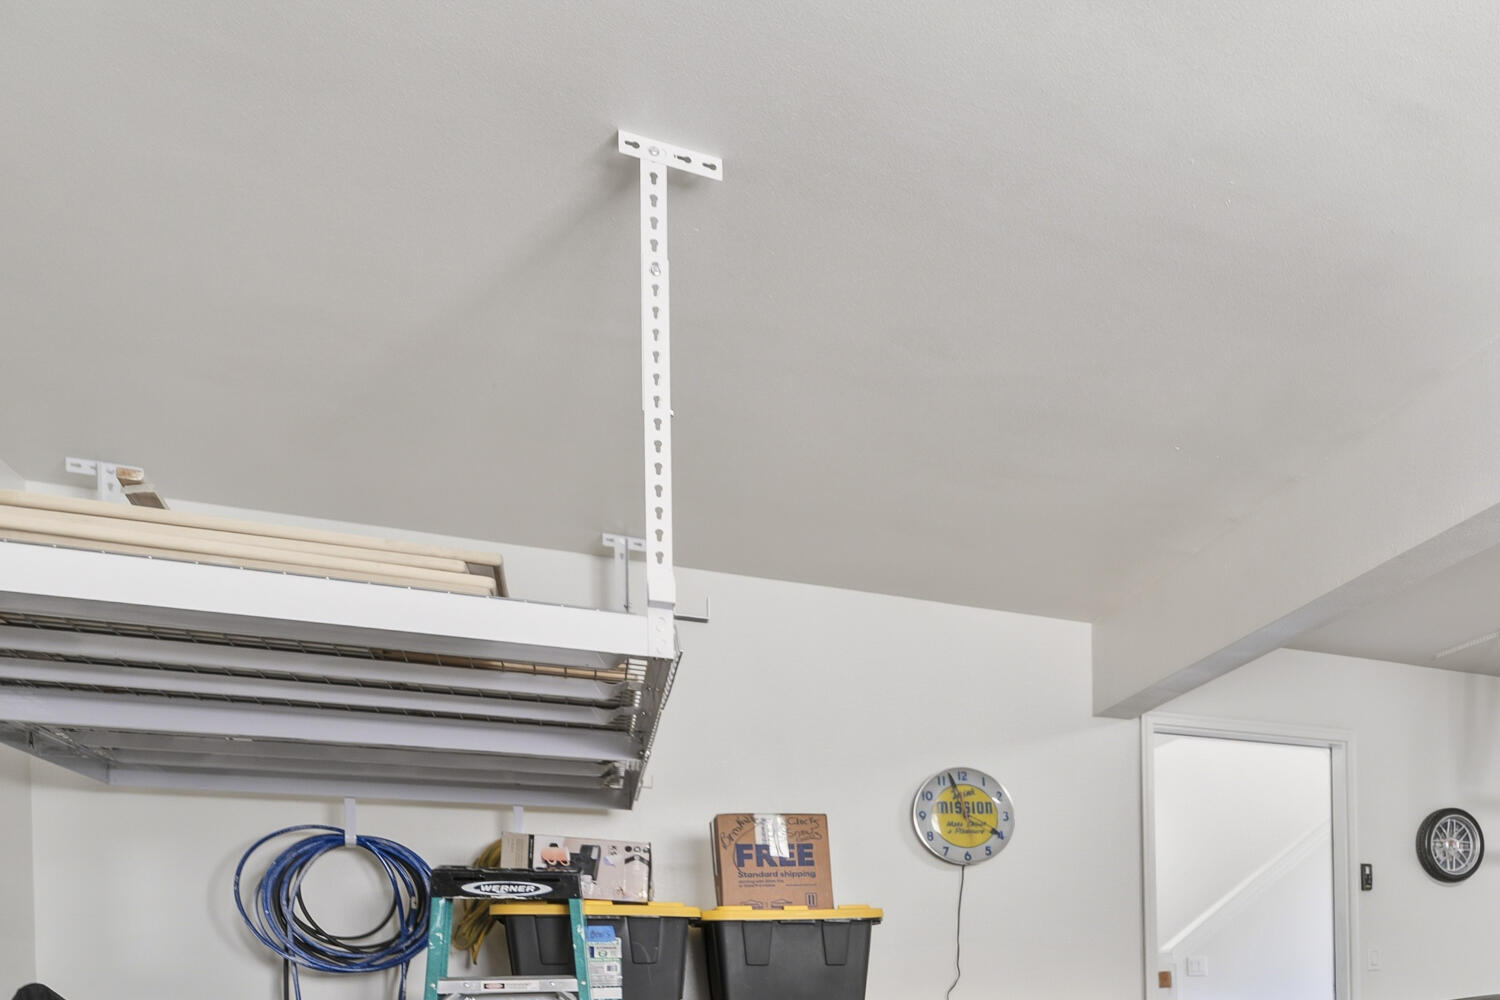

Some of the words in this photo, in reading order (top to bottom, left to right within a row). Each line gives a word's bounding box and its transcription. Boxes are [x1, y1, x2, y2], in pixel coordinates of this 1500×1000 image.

[921, 790, 933, 801] 10
[918, 811, 927, 820] 9
[1003, 811, 1009, 821] 3
[927, 831, 934, 841] 8
[735, 843, 815, 867] FREE
[943, 847, 950, 856] 7
[964, 851, 972, 861] 6
[985, 846, 992, 856] 5
[737, 870, 779, 879] Standard
[780, 870, 816, 879] shipping
[480, 883, 536, 893] WERNER
